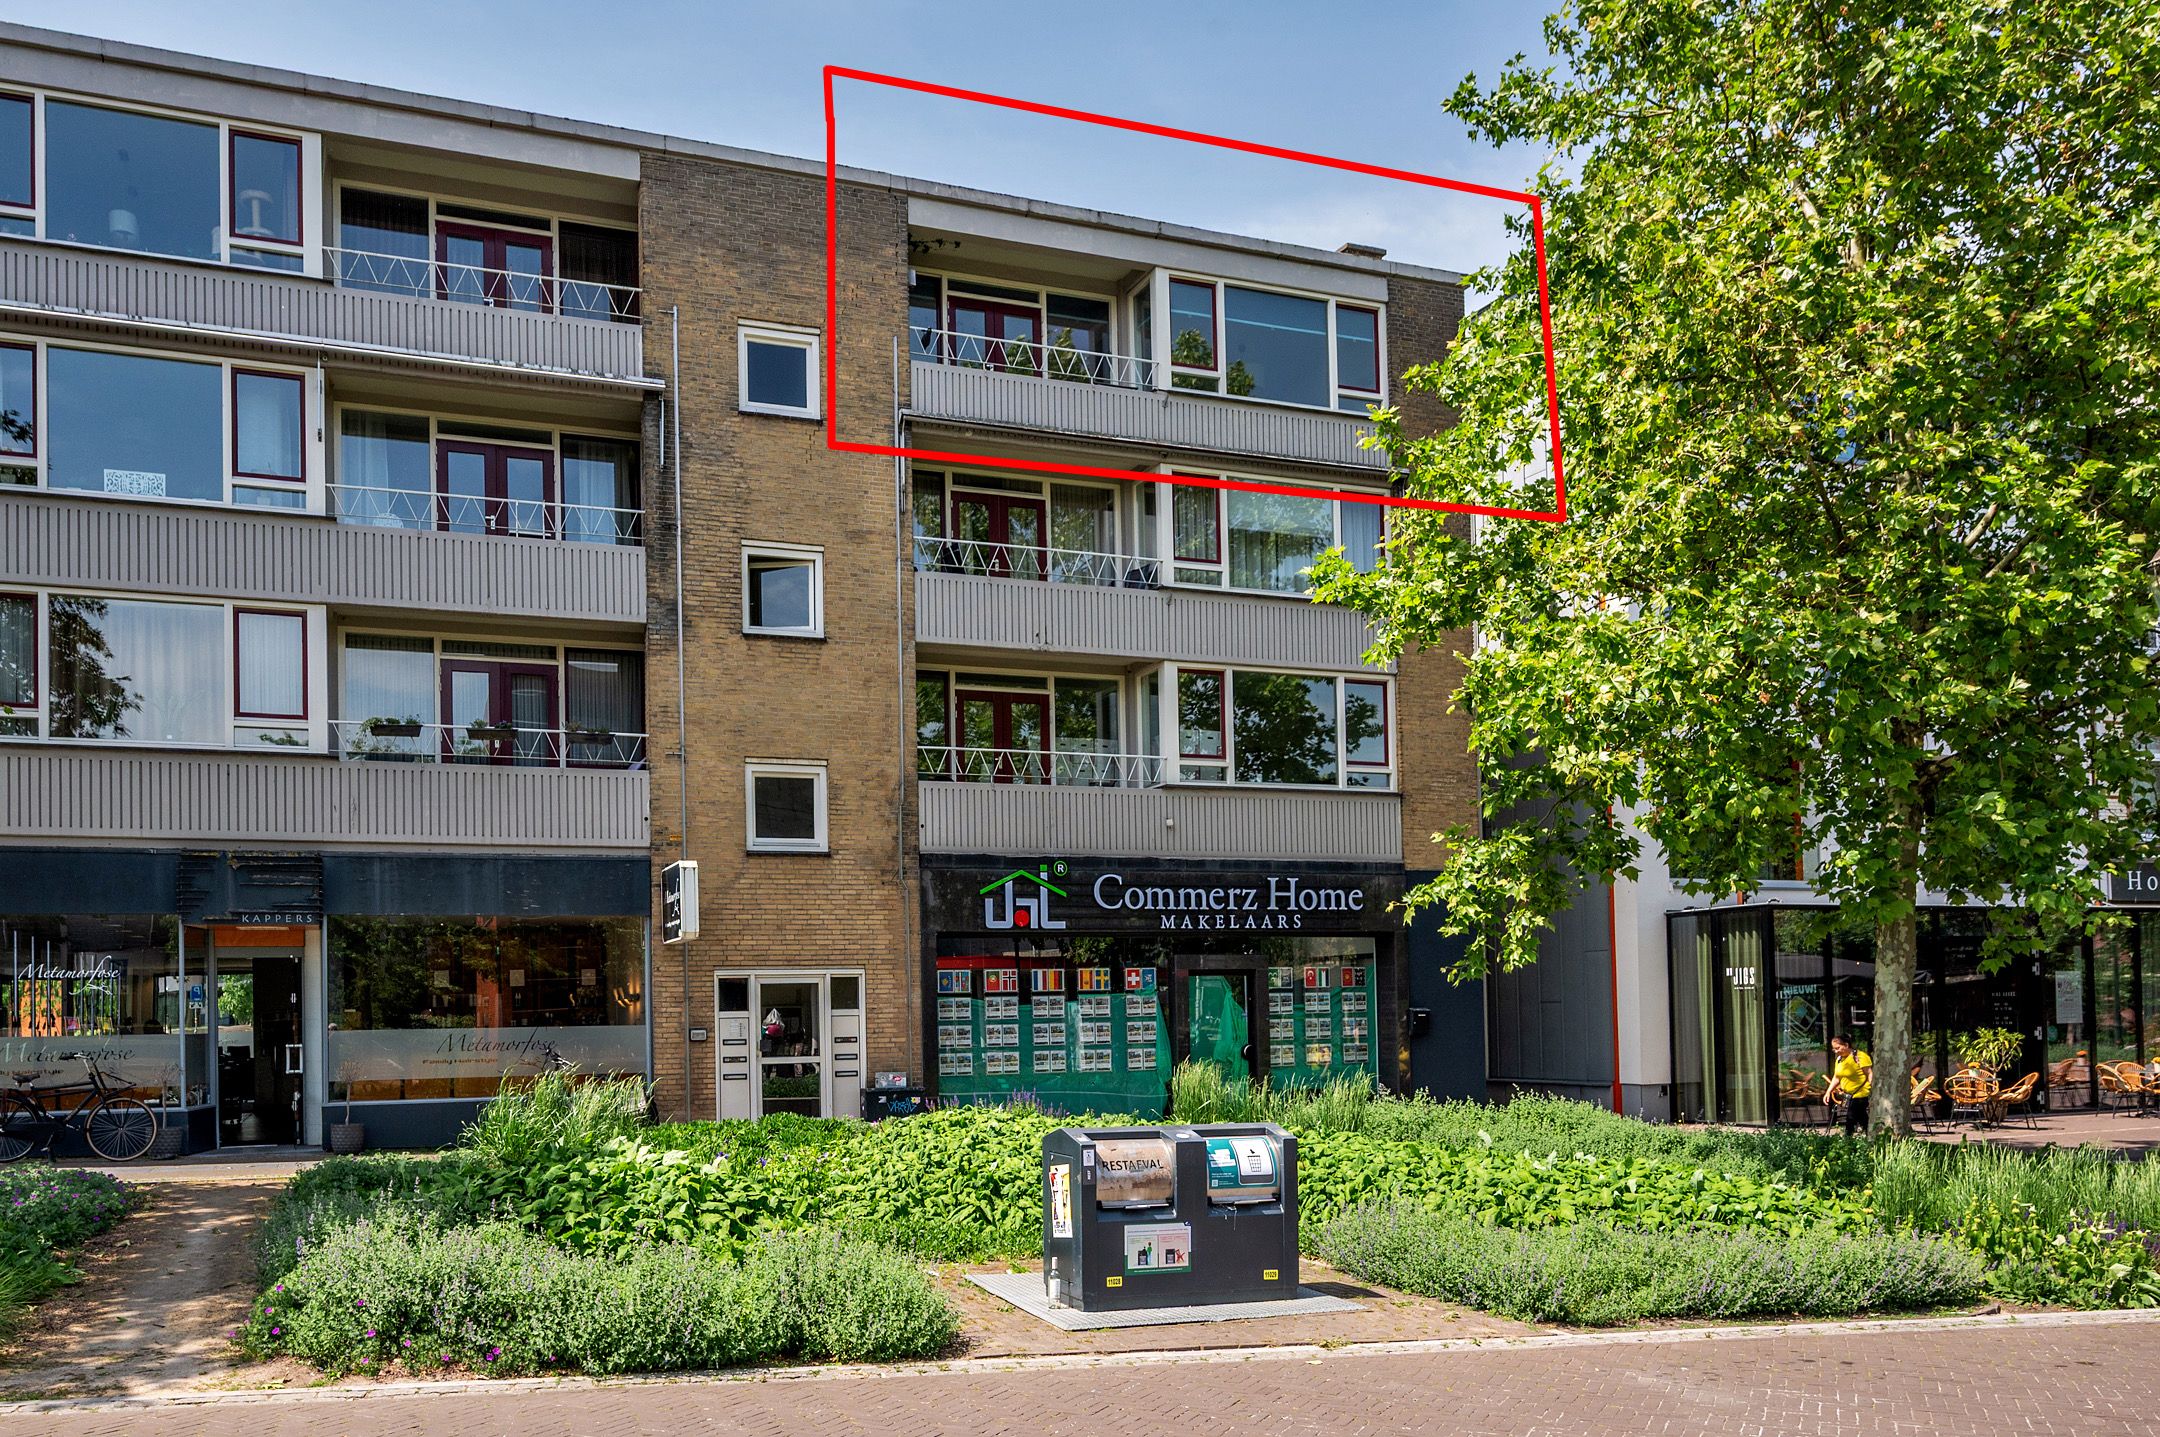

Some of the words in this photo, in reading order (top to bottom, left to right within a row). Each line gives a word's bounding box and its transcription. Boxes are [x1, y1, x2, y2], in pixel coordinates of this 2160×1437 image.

[1093, 873, 1258, 911] Commerz
[1267, 877, 1364, 911] Home
[242, 914, 313, 923] KAPPERS
[1160, 914, 1302, 929] MAKELAARS
[18, 955, 120, 996] Metamorfose
[437, 1026, 557, 1058] Metamorfose
[1102, 1159, 1163, 1171] RESTAFVAL
